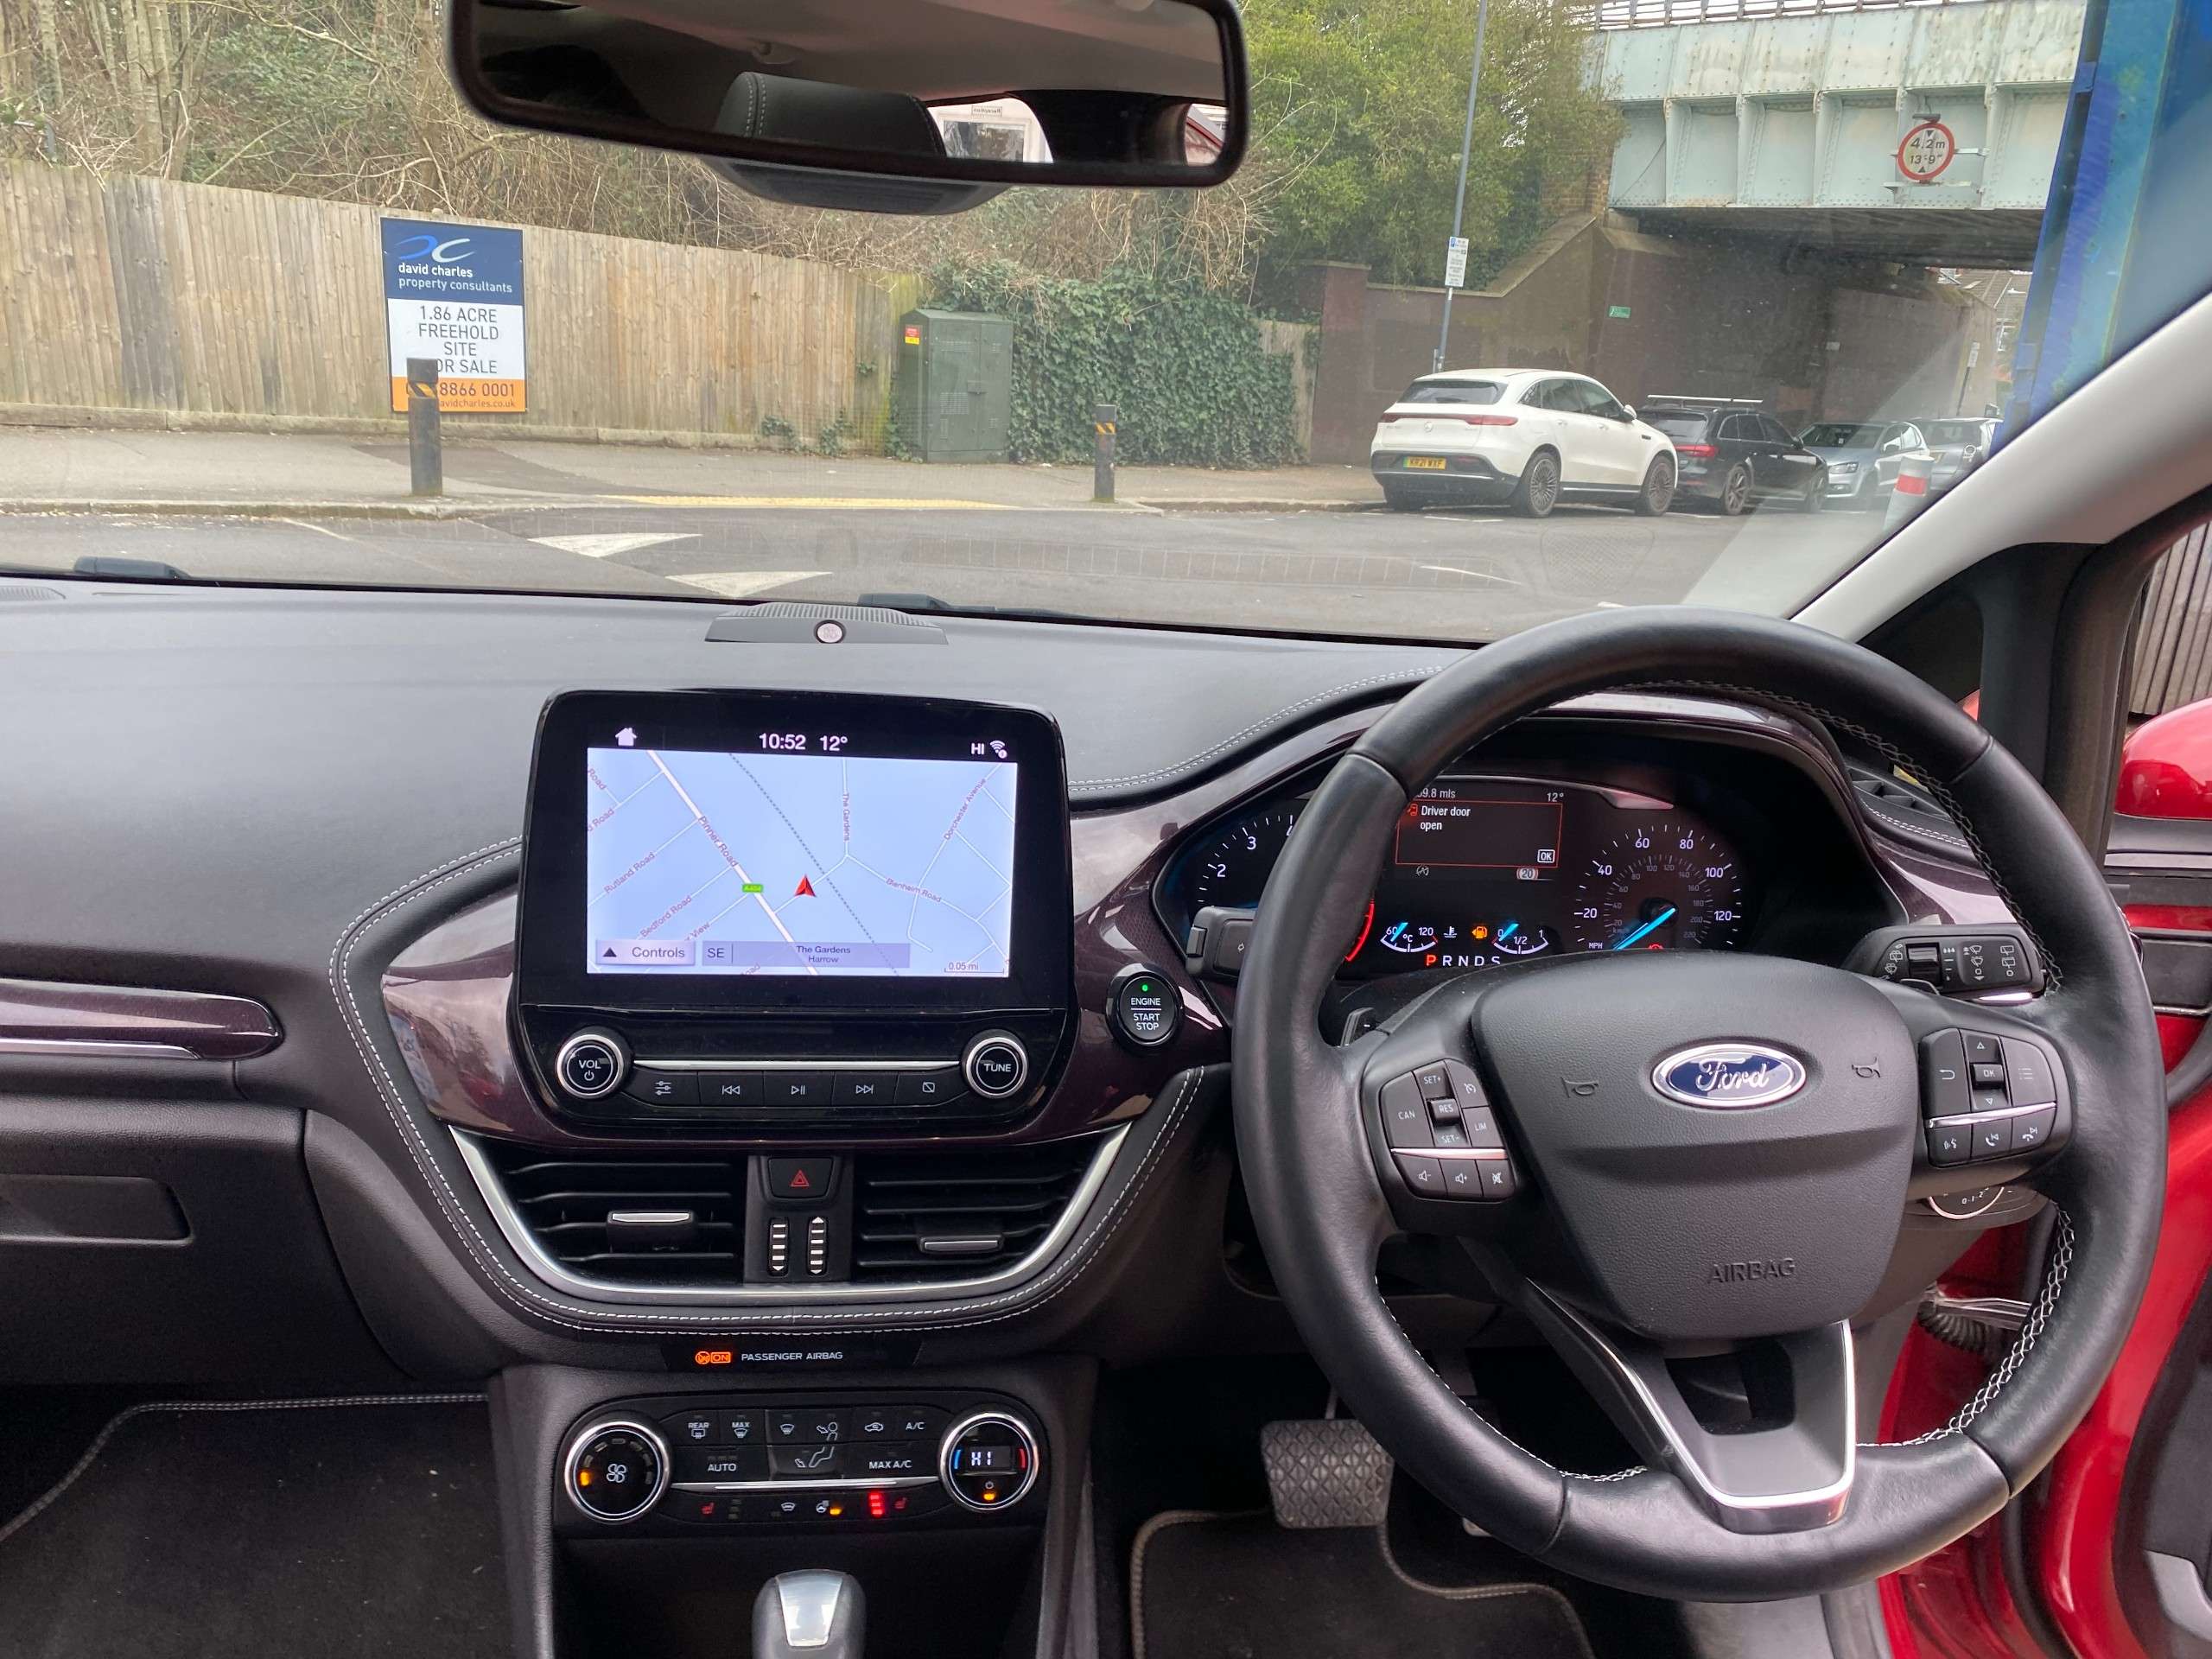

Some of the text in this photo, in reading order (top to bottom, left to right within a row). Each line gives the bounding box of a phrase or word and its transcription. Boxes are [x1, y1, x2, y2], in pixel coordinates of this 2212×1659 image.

[398, 262, 473, 277] david charles
[398, 277, 512, 292] property consultants
[420, 306, 497, 323] 1.86 ACRE
[418, 323, 499, 340] FREEHOLD
[443, 342, 477, 356] SITE
[436, 359, 497, 374] OR SALE
[439, 382, 514, 397] 8866 0001
[760, 733, 985, 755] 10:52 12° HI
[587, 768, 606, 790] Road
[1440, 788, 1456, 798] mls
[1547, 792, 1564, 802] 12°
[943, 778, 987, 841] Dorchester Avenue
[1421, 805, 1471, 817] Driver door
[593, 808, 615, 829] Road
[1420, 822, 1443, 832] open
[698, 816, 739, 867] Pinner Road
[1247, 836, 1257, 850] 3
[1635, 838, 1650, 849] 60
[1679, 839, 1694, 850] 80
[1540, 852, 1552, 861] OK
[604, 852, 655, 893] Rutland Road
[1217, 864, 1227, 877] 2
[1521, 868, 1534, 878] 20
[1598, 865, 1612, 876] 40
[1705, 868, 1723, 878] 100
[921, 888, 942, 903] Road
[640, 895, 692, 938] Bedford Road
[1583, 908, 1598, 918] 20
[1714, 911, 1732, 922] 120
[690, 921, 710, 938] View
[1418, 927, 1434, 936] 120
[1538, 929, 1544, 938] 1
[1513, 936, 1528, 945] 1/2
[632, 947, 685, 958] Controls
[707, 945, 851, 958] SE The Gardens
[808, 955, 839, 964] Harrow
[1427, 954, 1500, 967] P R N D S
[949, 960, 979, 971] 0.05 mi
[1133, 1013, 1160, 1021] START
[1136, 1022, 1159, 1031] STOP
[578, 1059, 602, 1069] VOL
[983, 1063, 1012, 1072] TUNE
[1424, 1075, 1441, 1084] SET+
[1695, 1058, 1769, 1091] Ford
[1983, 1070, 1995, 1078] OK
[1439, 1104, 1454, 1113] RES
[1398, 1111, 1416, 1120] CAN
[1475, 1122, 1487, 1131] LIM
[1709, 1258, 1796, 1283] AIRBAG
[741, 1352, 803, 1361] PASSENGER
[806, 1351, 843, 1360] AIRBAG
[906, 1422, 926, 1430] A/C
[708, 1463, 737, 1472] AUTO
[869, 1460, 912, 1469] MAX A/C
